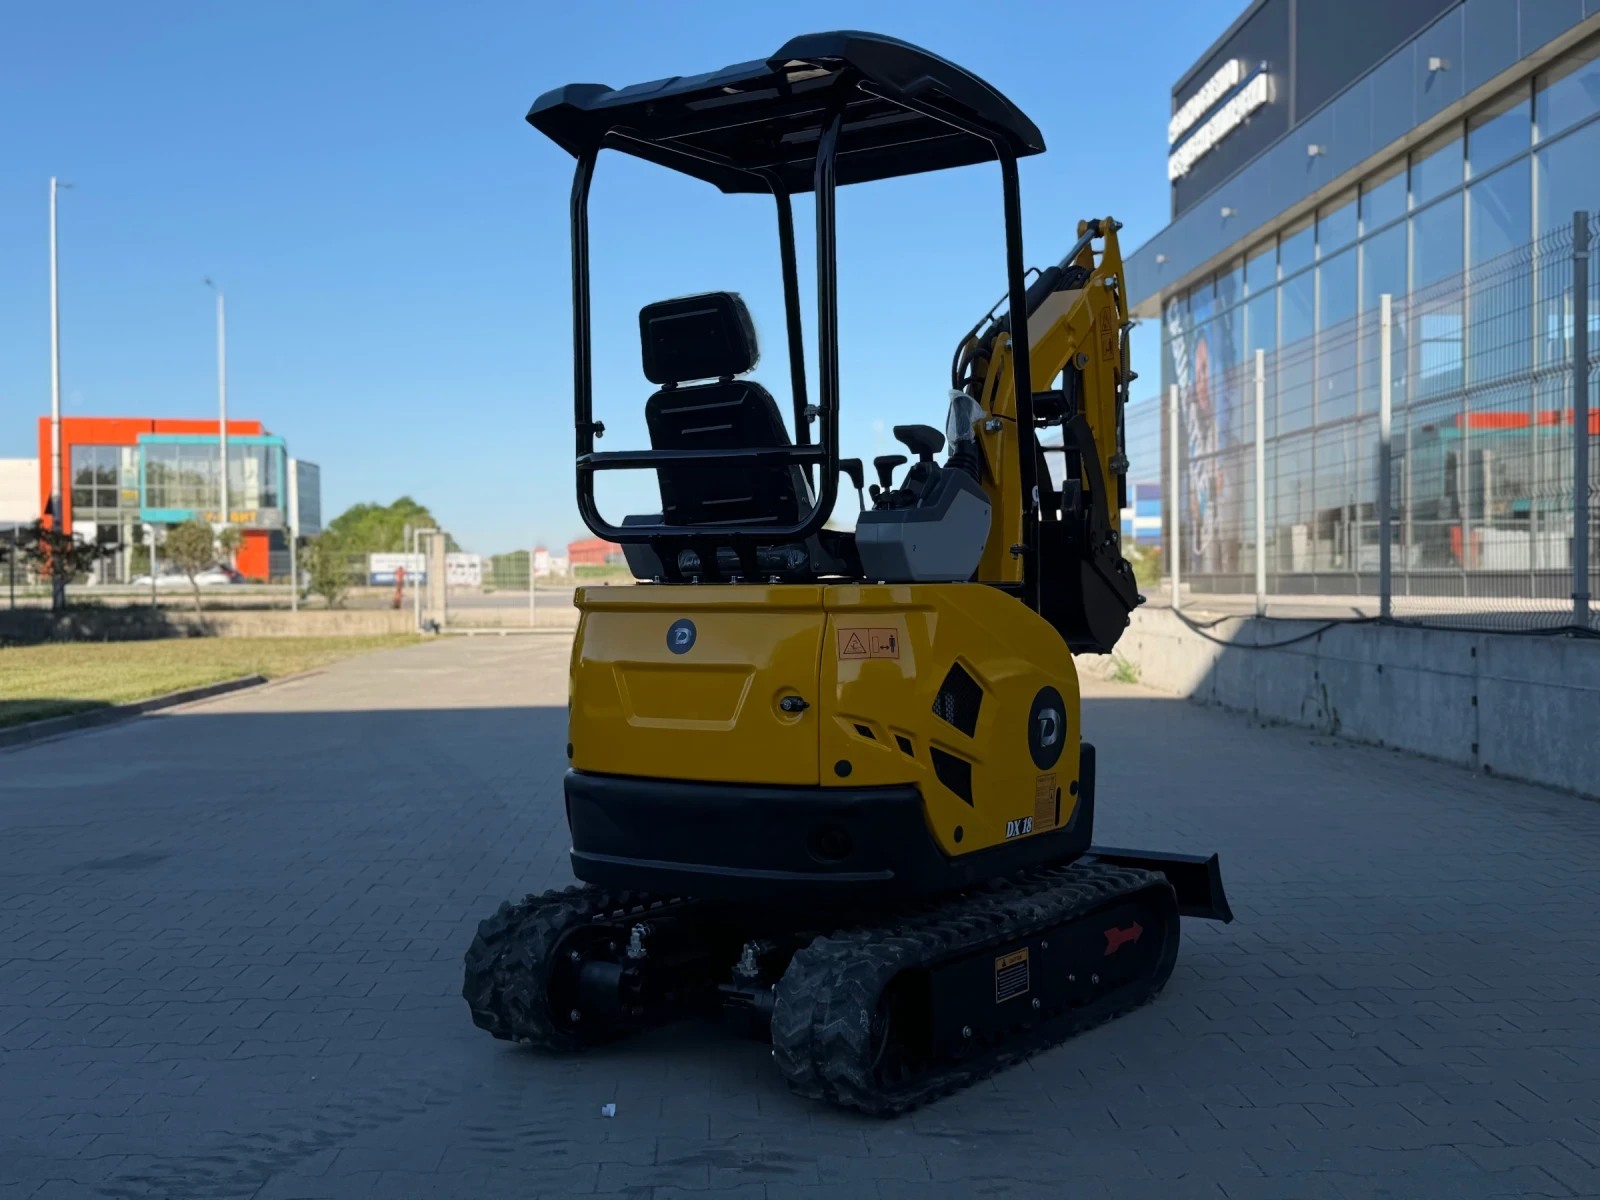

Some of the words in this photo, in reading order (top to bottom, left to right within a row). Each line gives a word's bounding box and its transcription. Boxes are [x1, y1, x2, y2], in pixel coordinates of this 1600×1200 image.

[1037, 707, 1061, 748] D
[1005, 819, 1021, 838] DX
[1022, 816, 1033, 834] 18
